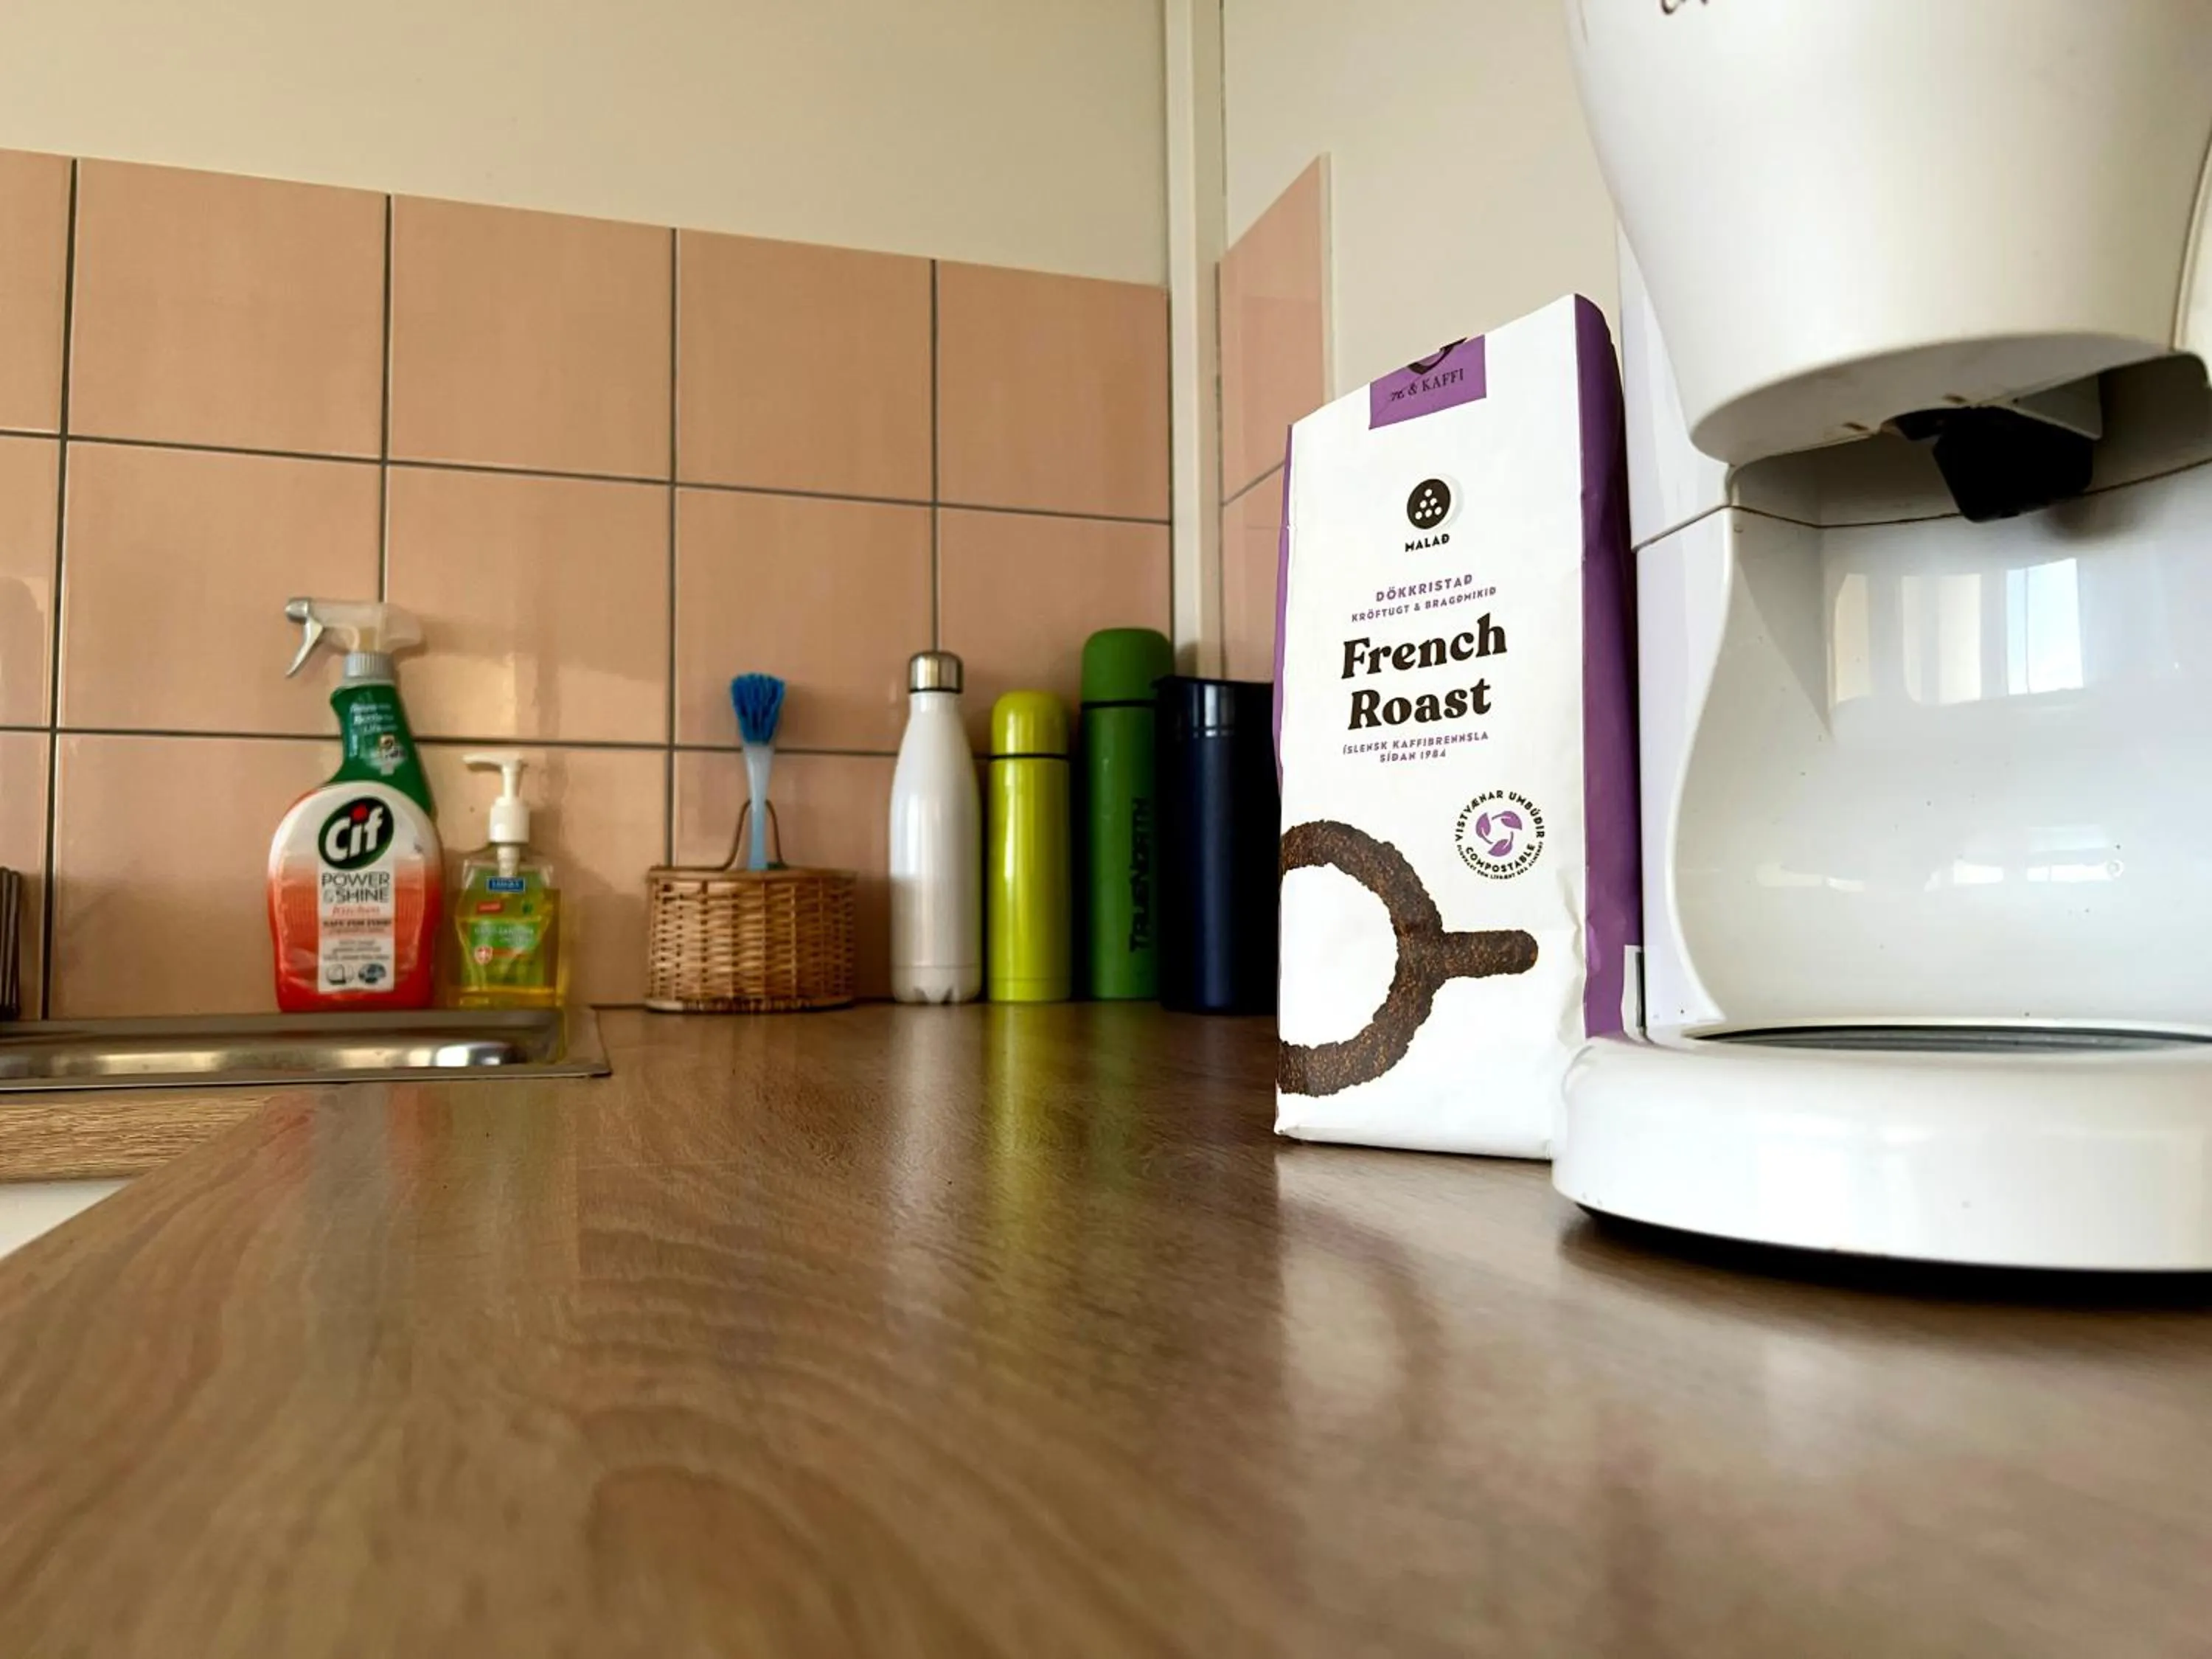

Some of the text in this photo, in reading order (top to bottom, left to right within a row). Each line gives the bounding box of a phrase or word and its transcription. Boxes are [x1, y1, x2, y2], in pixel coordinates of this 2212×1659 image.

[1408, 383, 1417, 395] &
[1422, 368, 1464, 392] KAFFI
[1352, 605, 1410, 622] KRÖFTUGT
[1413, 602, 1421, 611] &
[1341, 612, 1508, 679] French
[1347, 678, 1492, 730] Roast
[1419, 748, 1447, 760] 1984
[325, 802, 383, 862] Cif
[1464, 843, 1536, 873] COMPOSTABLE
[321, 872, 391, 887] POWER
[335, 887, 390, 904] SHINE
